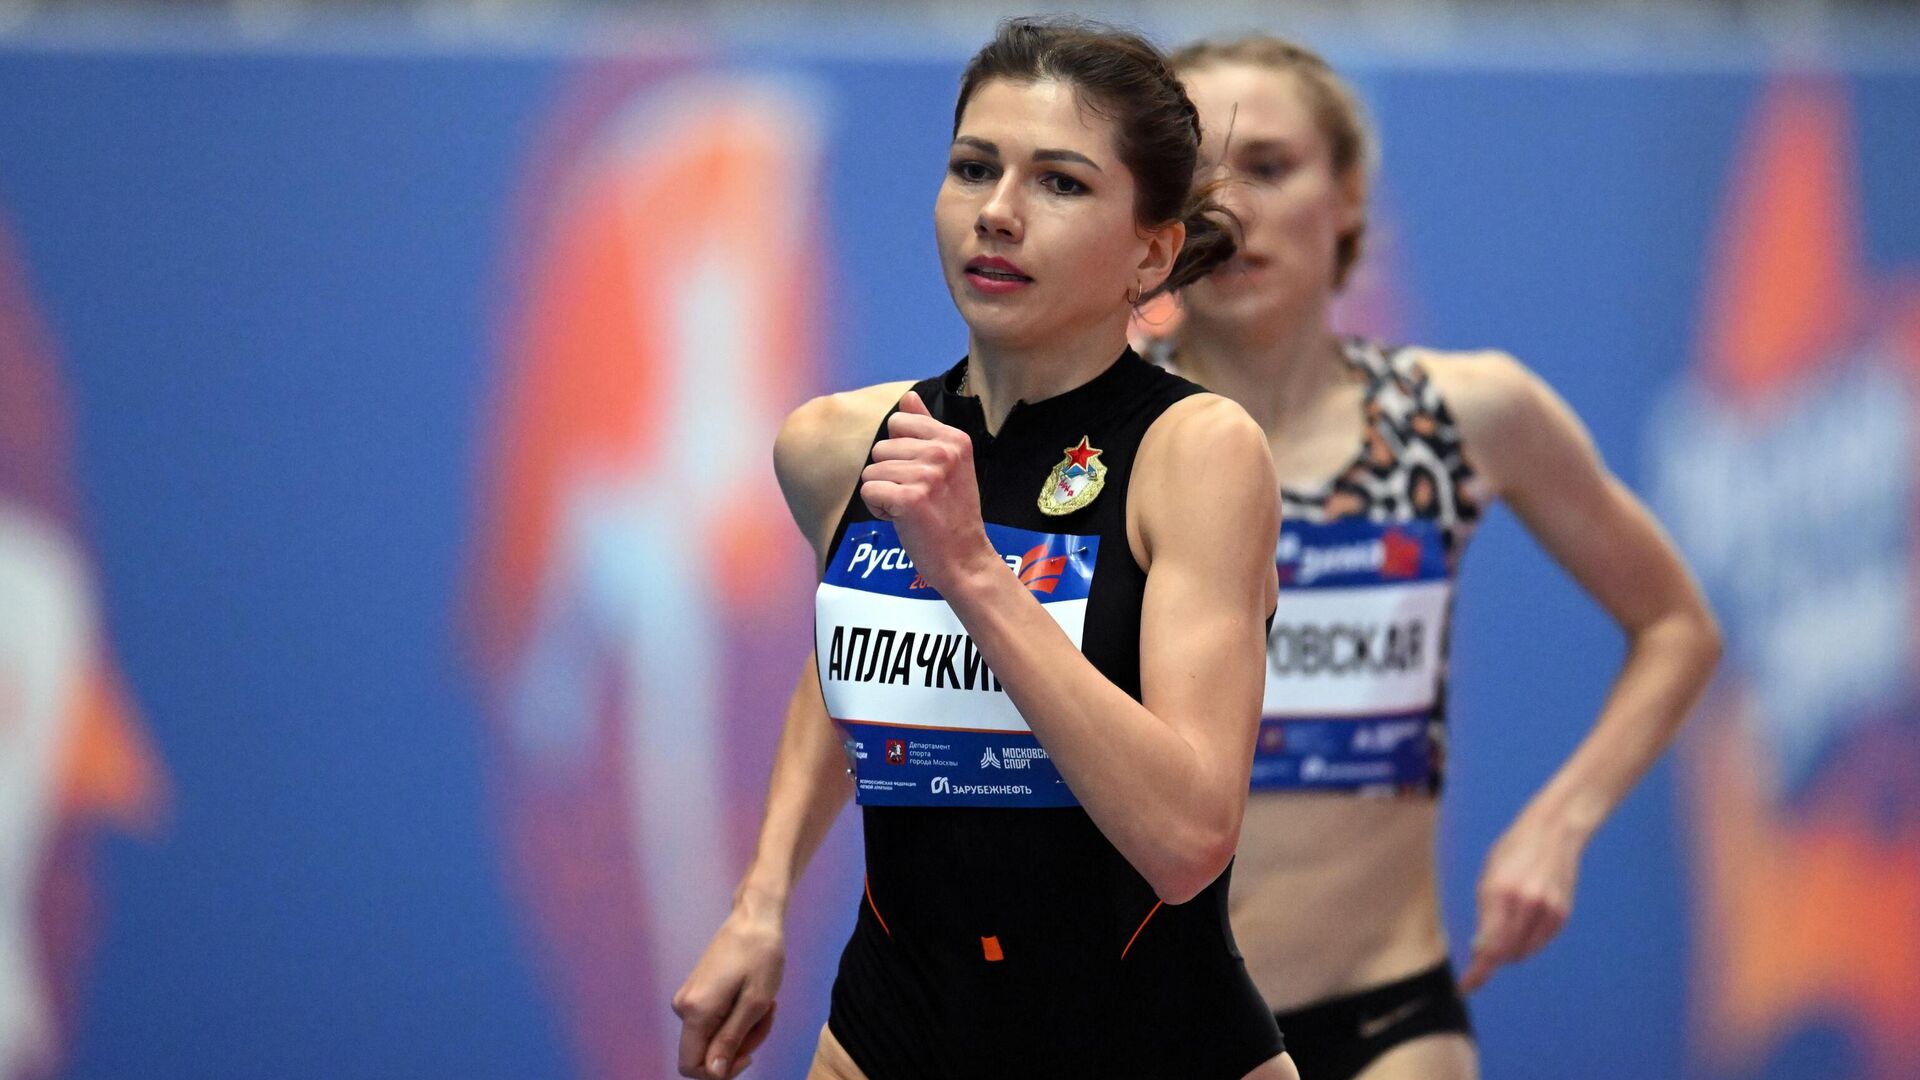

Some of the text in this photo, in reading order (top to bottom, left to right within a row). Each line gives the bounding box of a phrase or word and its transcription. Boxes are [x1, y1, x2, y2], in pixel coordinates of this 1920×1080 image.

[847, 543, 913, 578] Русс
[1268, 618, 1427, 677] ОВСКАЯ
[828, 625, 1003, 693] АПЛАЧКИ
[909, 741, 951, 751] Департамент
[909, 750, 931, 758] спорта
[1002, 747, 1049, 760] МОСКОВСК
[909, 758, 959, 767] города Москвы
[1003, 758, 1032, 770] СПОРТ
[952, 784, 1033, 795] ЗАРУБЕЖНЕФТЬ
